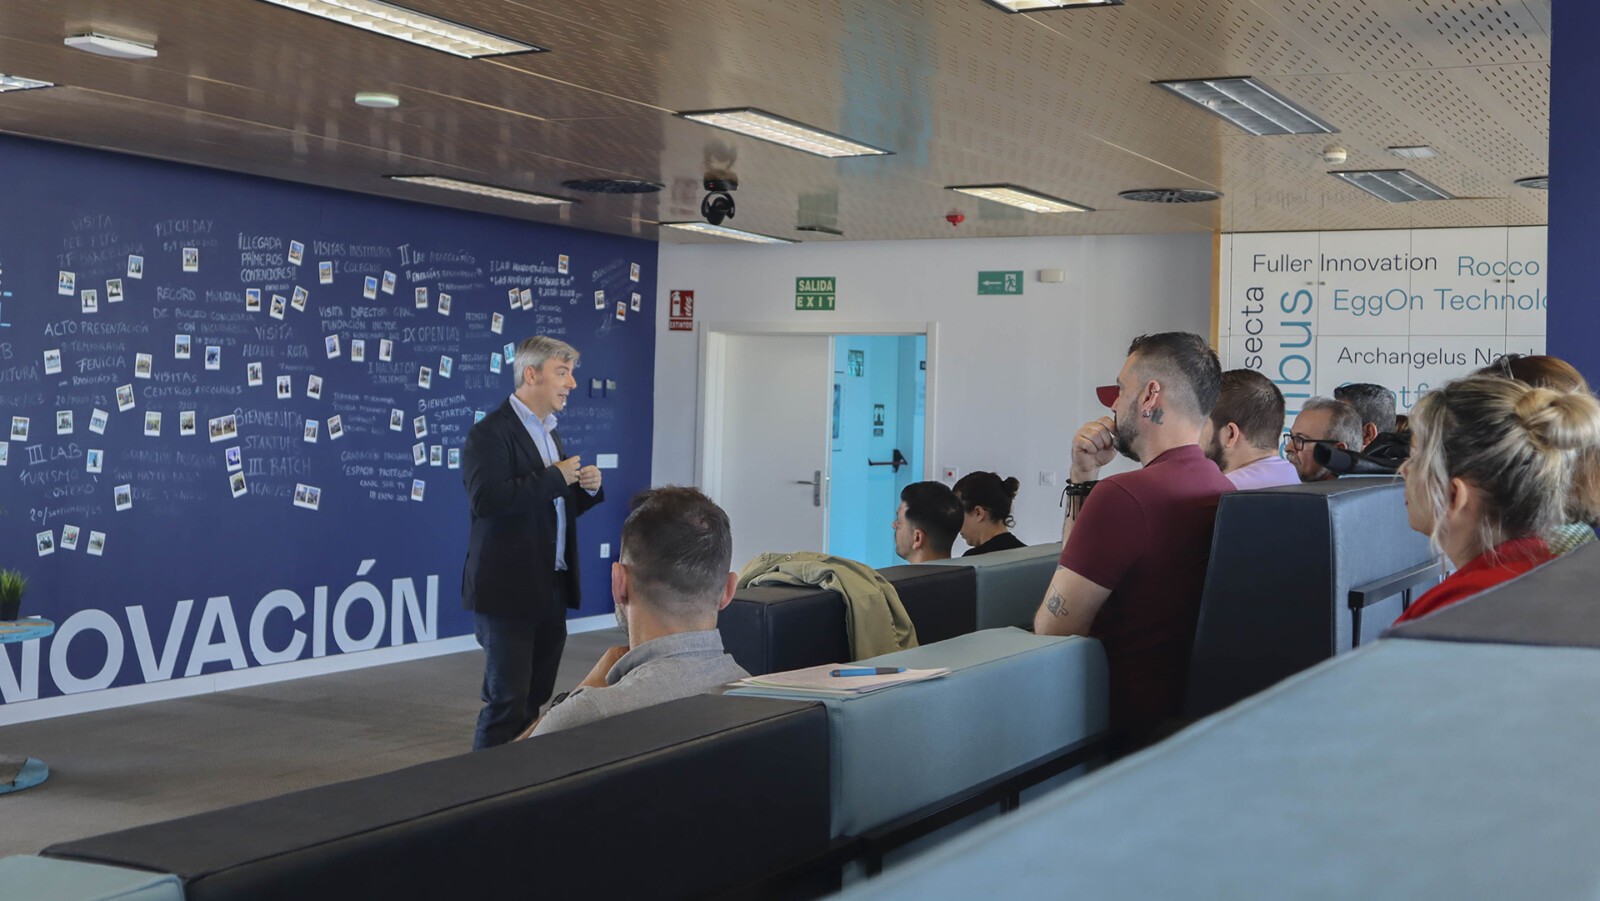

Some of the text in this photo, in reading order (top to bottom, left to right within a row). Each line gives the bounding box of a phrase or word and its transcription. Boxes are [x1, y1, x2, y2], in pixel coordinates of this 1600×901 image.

[192, 219, 214, 233] DAY
[313, 240, 346, 257] VISITAS
[1253, 253, 1540, 276] Fuller Innovation Rocco
[798, 280, 833, 292] SALIDA
[797, 296, 834, 307] EXIT
[1333, 288, 1424, 316] EggOn
[319, 305, 343, 317] VISITA
[45, 320, 78, 336] ACTO
[255, 324, 293, 341] VISITA
[418, 326, 443, 341] OPEN
[1337, 347, 1466, 368] Archangelus
[154, 371, 197, 384] VISITAS
[143, 386, 191, 398] CENTROS
[418, 394, 466, 413] BIENVENIDA
[233, 407, 303, 432] BIENVENIDA
[435, 406, 474, 421] STARTUPS
[50, 443, 82, 461] LAB
[245, 456, 311, 478] III BATCH
